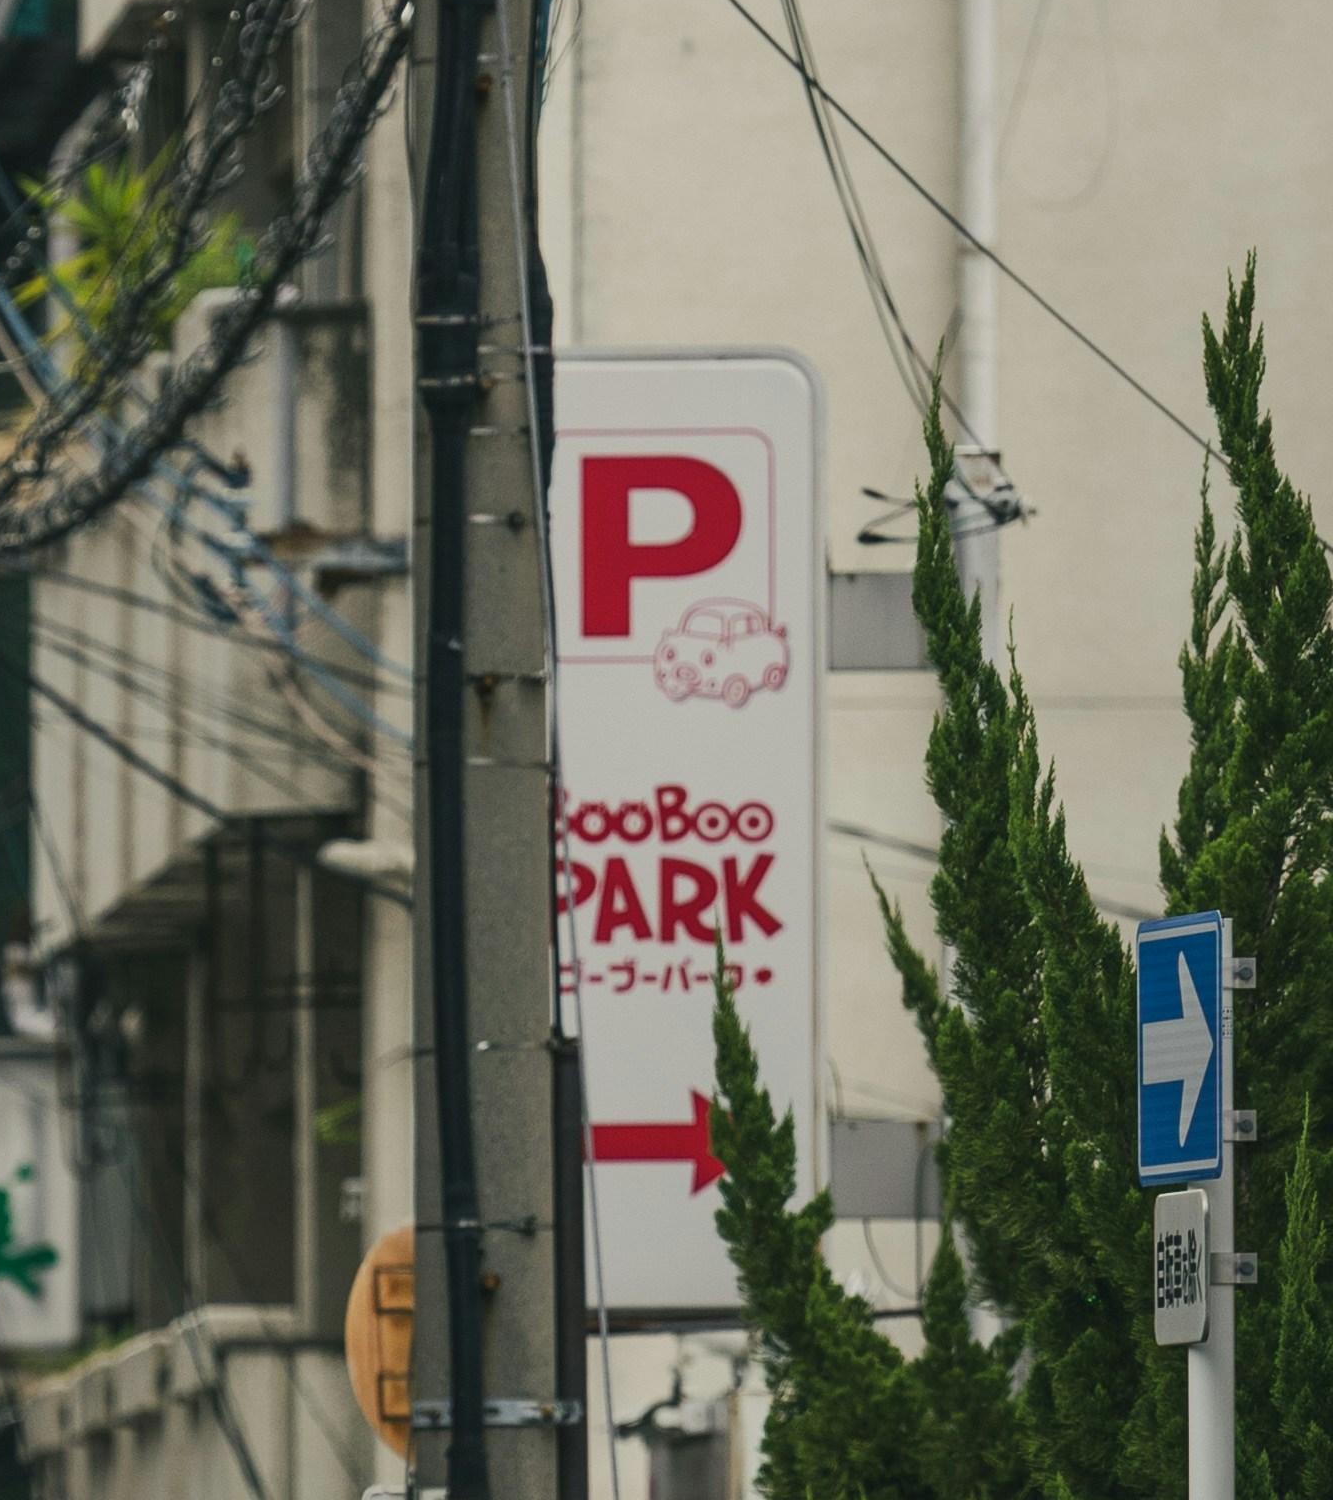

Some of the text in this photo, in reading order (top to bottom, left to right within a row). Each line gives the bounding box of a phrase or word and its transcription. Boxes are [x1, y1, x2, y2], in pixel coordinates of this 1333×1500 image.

[581, 454, 743, 638] P
[554, 853, 783, 944] PARK
[1156, 1228, 1204, 1309] 自転車を除く
